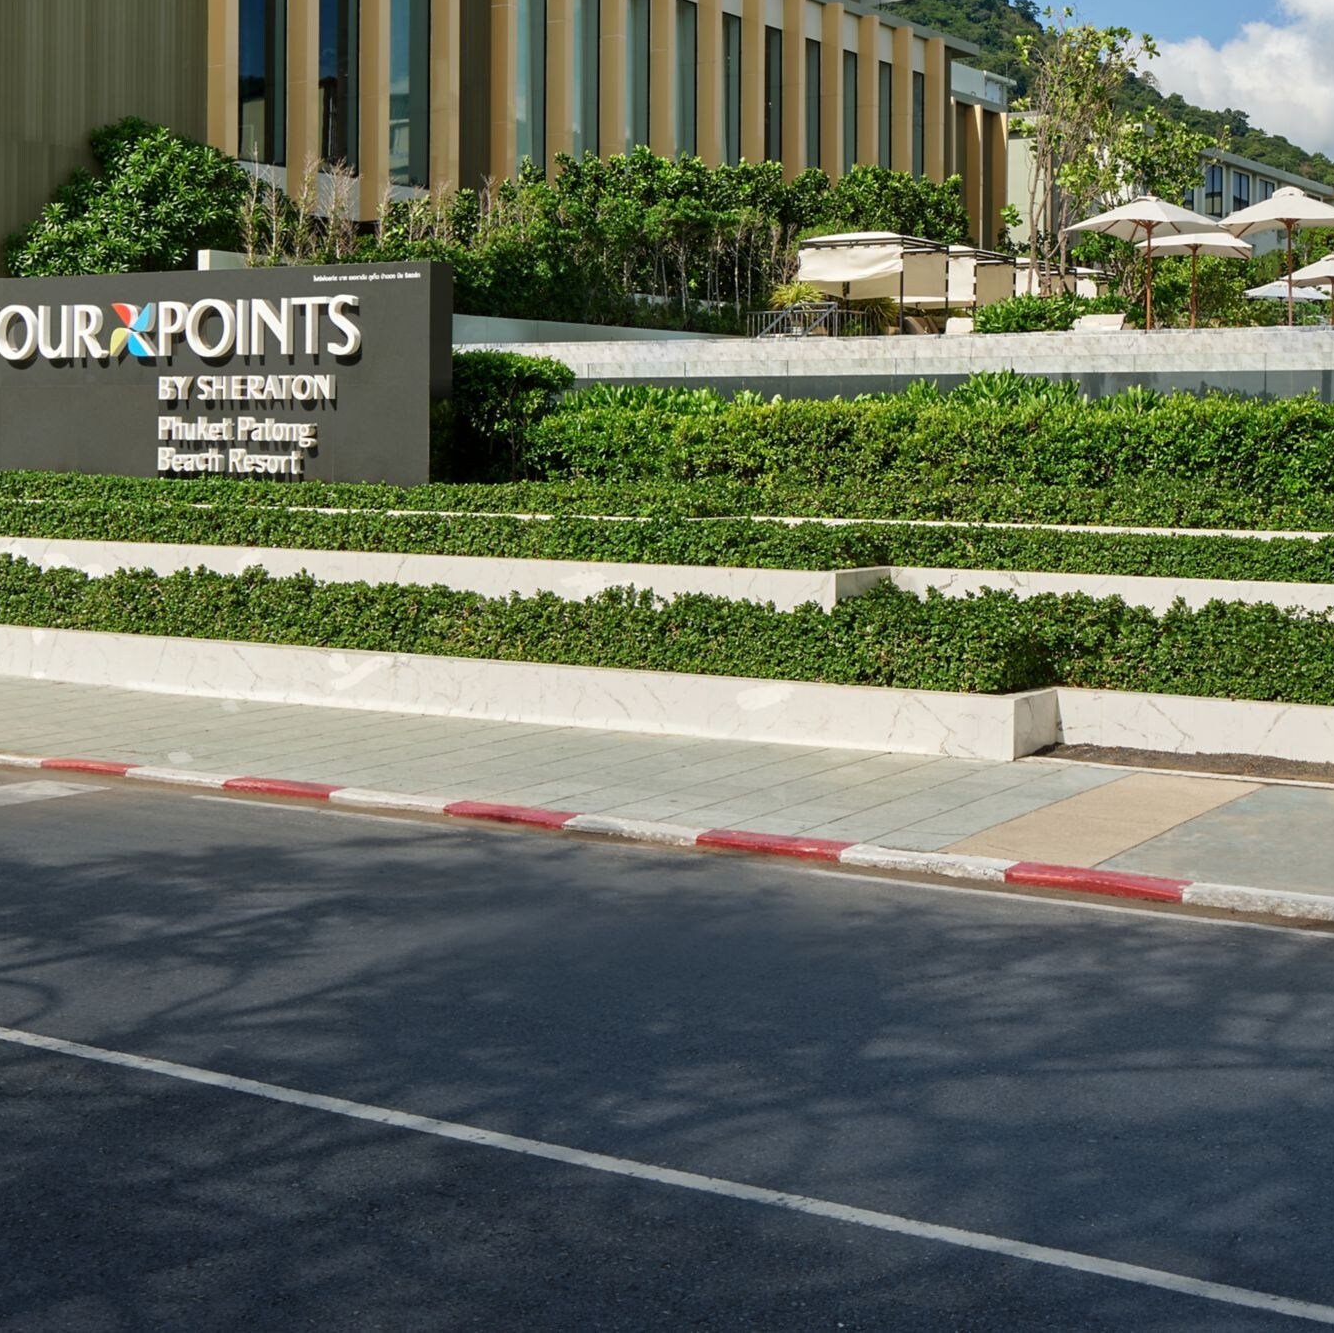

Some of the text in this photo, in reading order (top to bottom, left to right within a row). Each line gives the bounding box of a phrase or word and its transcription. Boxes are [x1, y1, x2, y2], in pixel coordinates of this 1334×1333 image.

[158, 294, 362, 358] POINTS
[157, 374, 337, 401] BY SHERATON
[157, 416, 318, 447] Phuket Patong
[157, 446, 302, 475] Beach Resort
